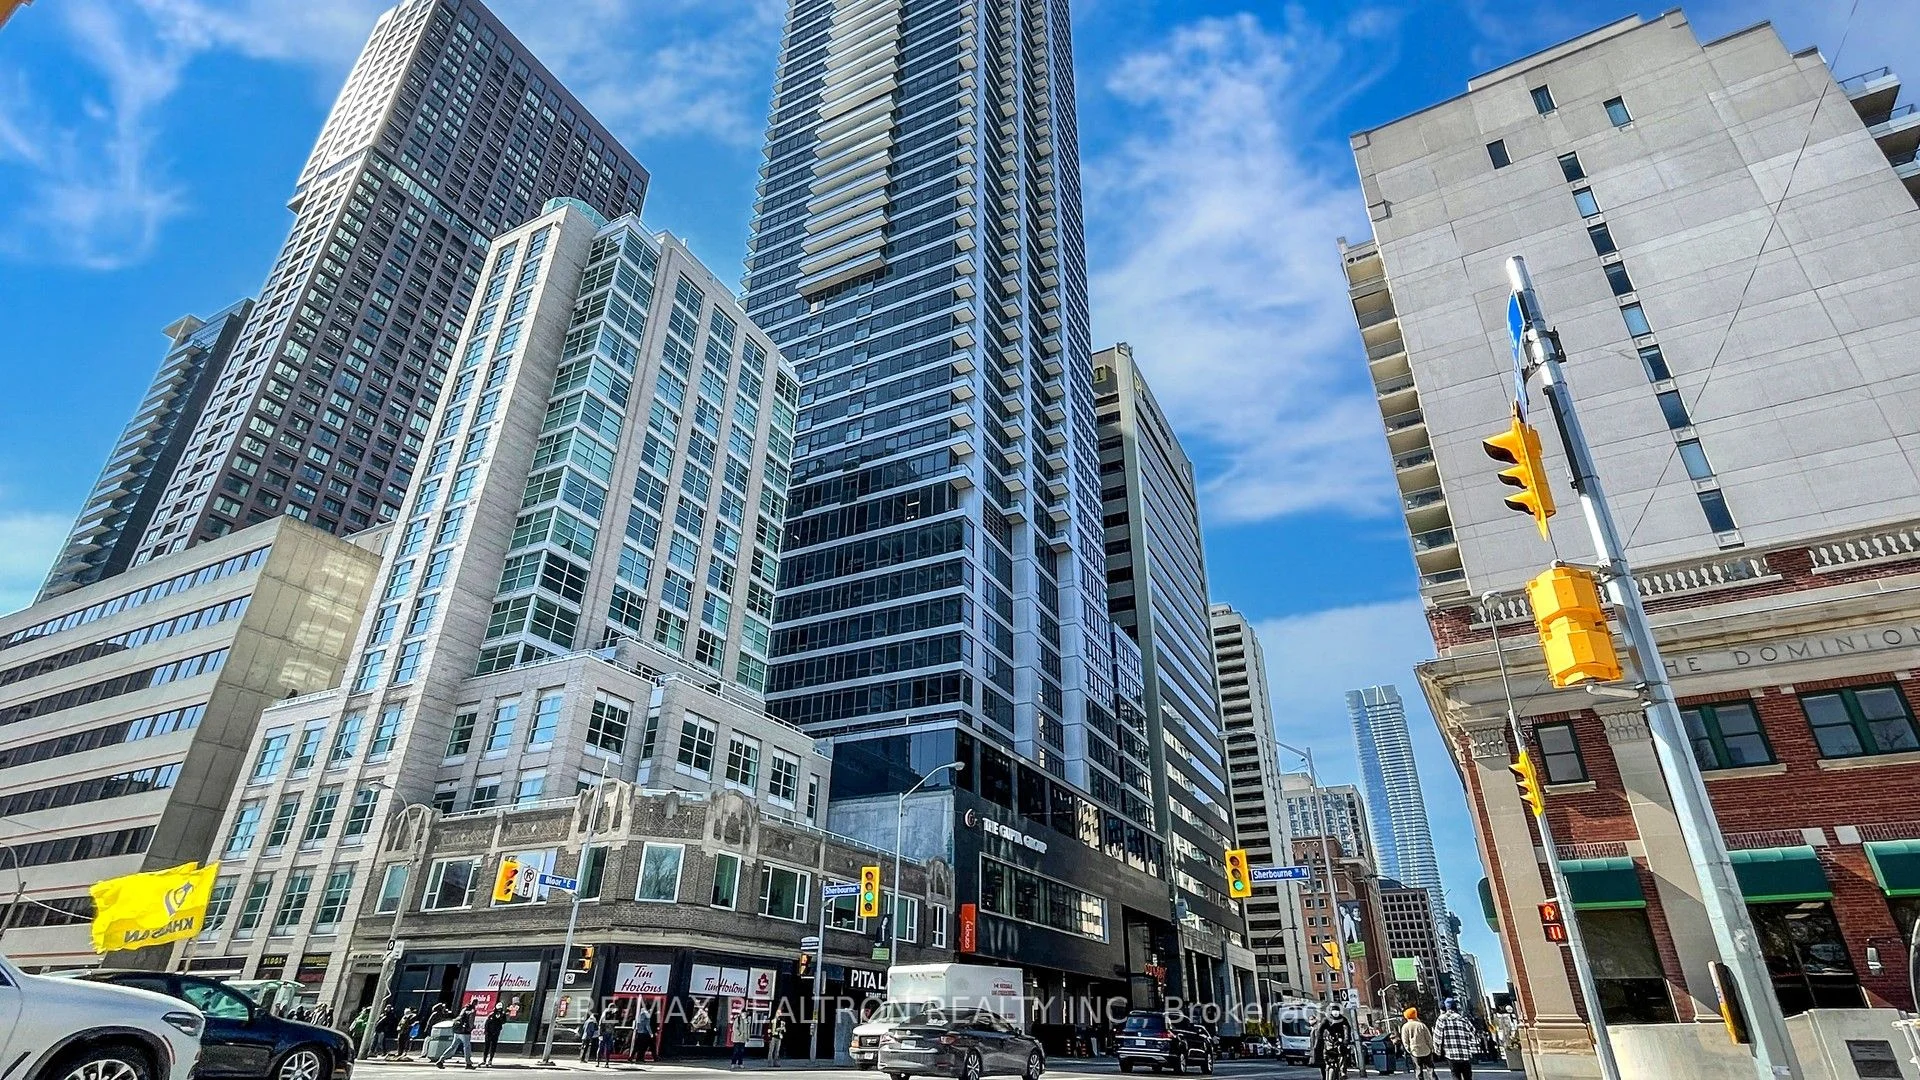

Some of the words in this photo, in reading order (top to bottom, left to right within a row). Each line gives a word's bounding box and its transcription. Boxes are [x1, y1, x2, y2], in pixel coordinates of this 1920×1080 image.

[1663, 656, 1702, 675] HE
[1253, 869, 1293, 880] Sherbourne
[1301, 867, 1308, 877] N
[825, 886, 857, 895] Sherbourne
[634, 965, 653, 979] Tim
[500, 973, 531, 987] Hortons
[621, 978, 663, 992] Hortons
[704, 977, 719, 992] Tim
[718, 978, 746, 994] Hortons
[850, 969, 877, 990] PITA
